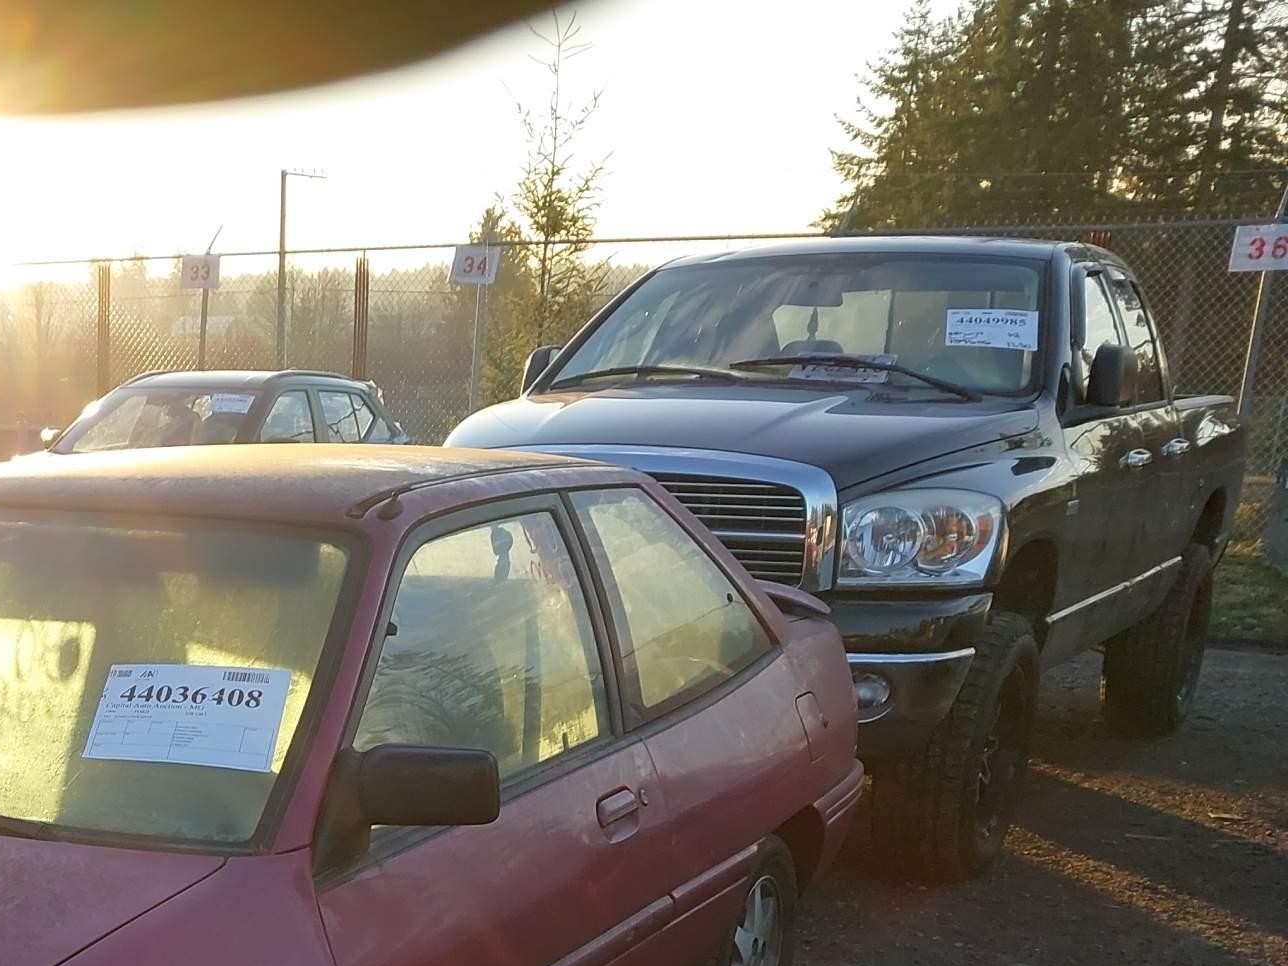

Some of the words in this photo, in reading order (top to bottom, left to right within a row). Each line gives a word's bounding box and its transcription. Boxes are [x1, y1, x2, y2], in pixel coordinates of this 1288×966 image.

[1248, 236, 1288, 260] 36
[190, 263, 210, 281] 33
[463, 256, 487, 275] 34
[956, 316, 1027, 326] 44049985
[119, 684, 263, 709] 44036408
